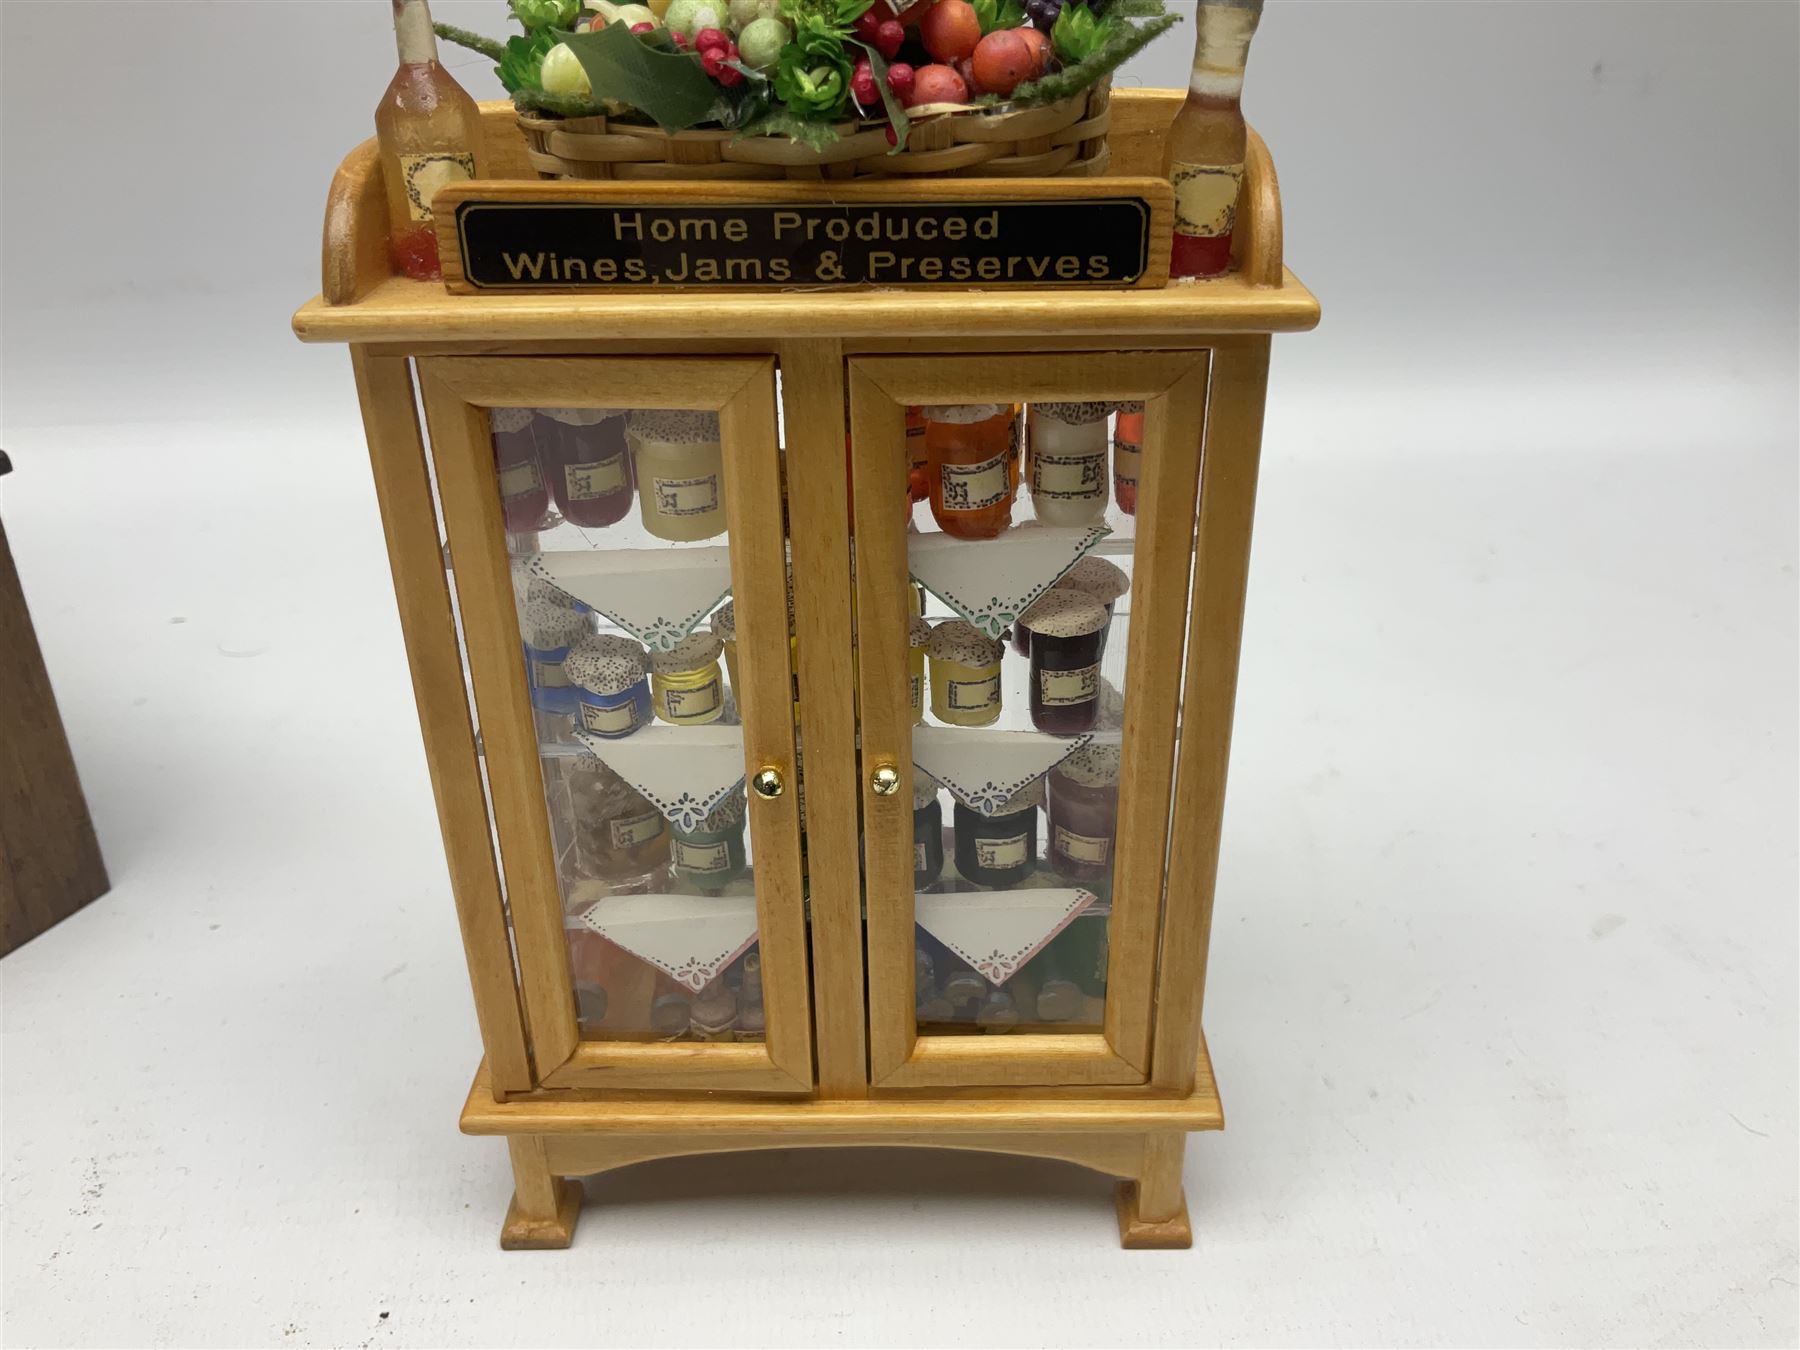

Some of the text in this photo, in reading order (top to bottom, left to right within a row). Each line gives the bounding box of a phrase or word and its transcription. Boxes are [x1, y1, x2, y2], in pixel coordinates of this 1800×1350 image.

[613, 210, 1000, 243] Home Produced
[814, 250, 846, 281] &
[867, 250, 1111, 282] Preserves
